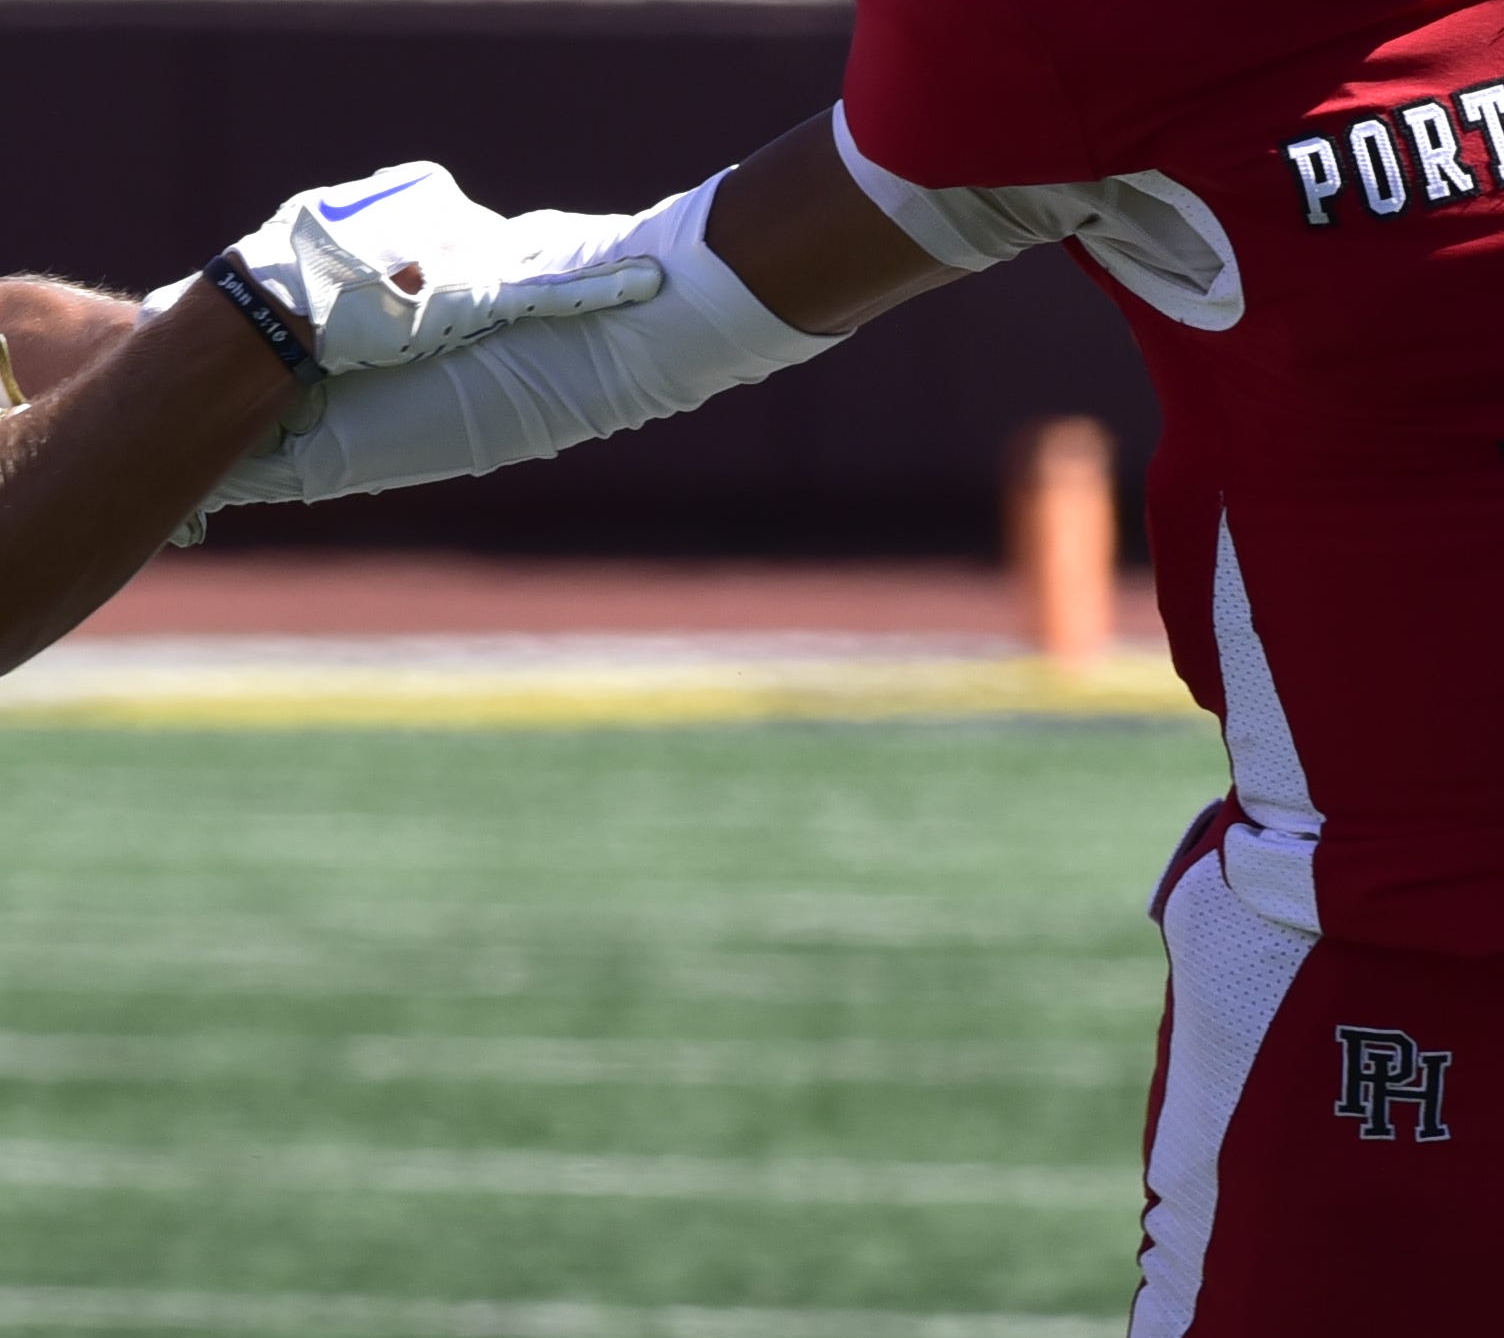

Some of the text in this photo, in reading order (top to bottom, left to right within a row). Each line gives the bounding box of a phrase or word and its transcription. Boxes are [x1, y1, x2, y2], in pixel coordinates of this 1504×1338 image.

[217, 272, 288, 342] John 3:16
[1334, 1025, 1452, 1143] PH
